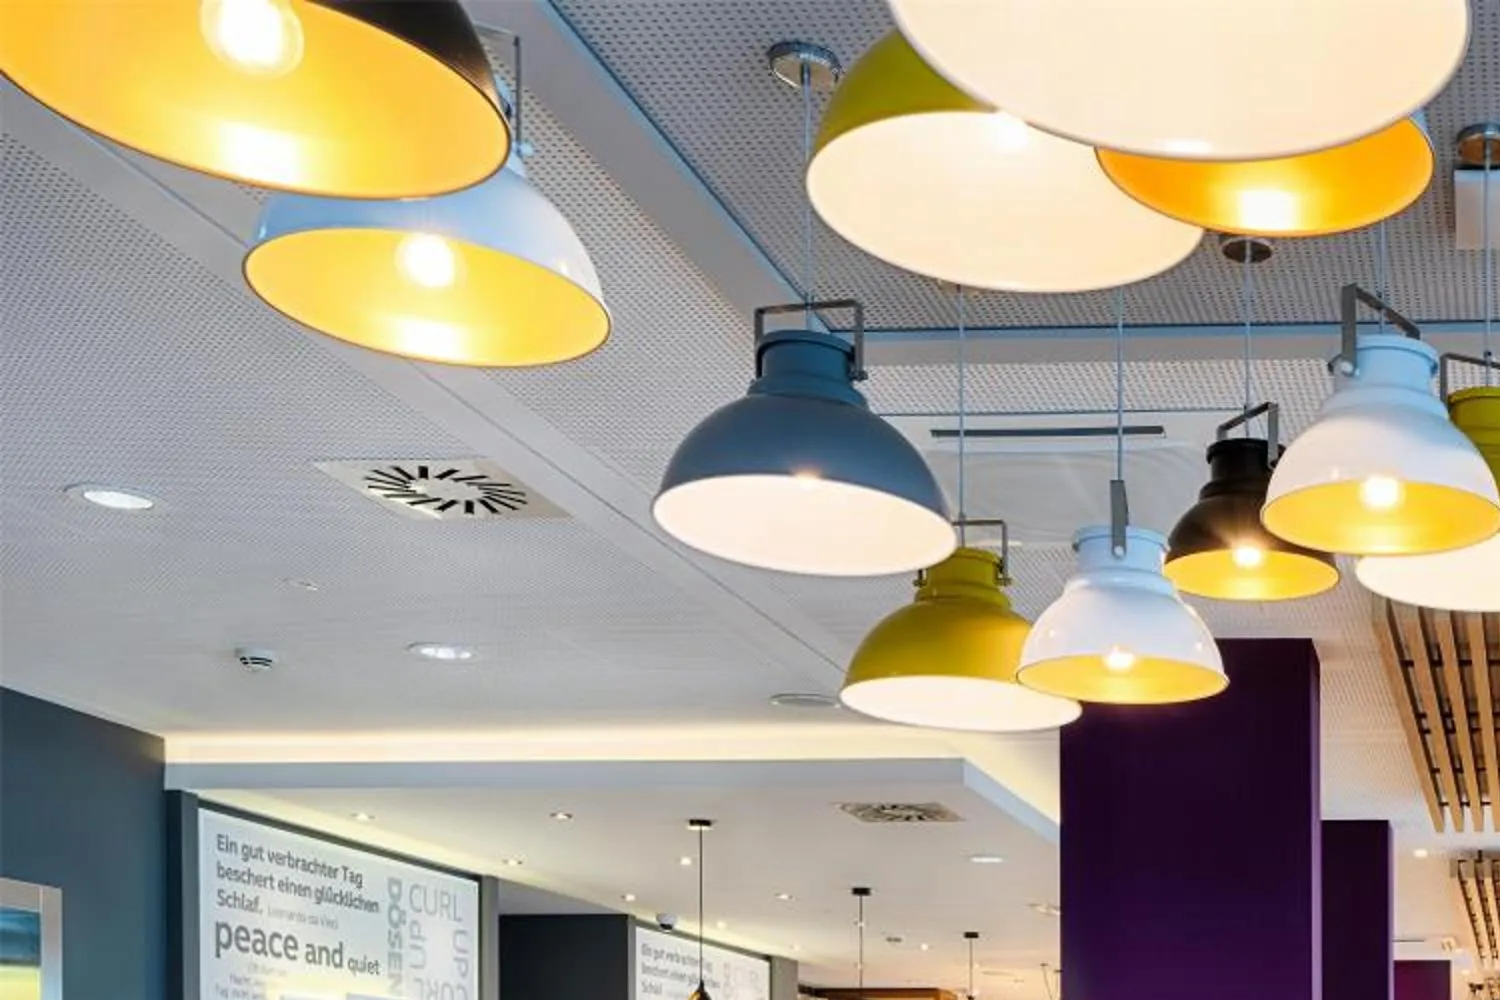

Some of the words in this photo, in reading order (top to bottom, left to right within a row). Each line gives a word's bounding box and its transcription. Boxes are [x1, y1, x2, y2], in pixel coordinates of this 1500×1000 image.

[216, 833, 239, 853] Ein
[241, 842, 265, 862] gut
[267, 850, 339, 879] verbrachter
[341, 865, 363, 888] Tag
[216, 860, 275, 890] beschert
[277, 877, 312, 898] einen
[314, 886, 380, 913] glücklichen
[409, 884, 463, 922] CURL
[215, 921, 299, 961] peace
[305, 941, 344, 969] and
[347, 955, 380, 978] quiet
[452, 929, 469, 978] UP
